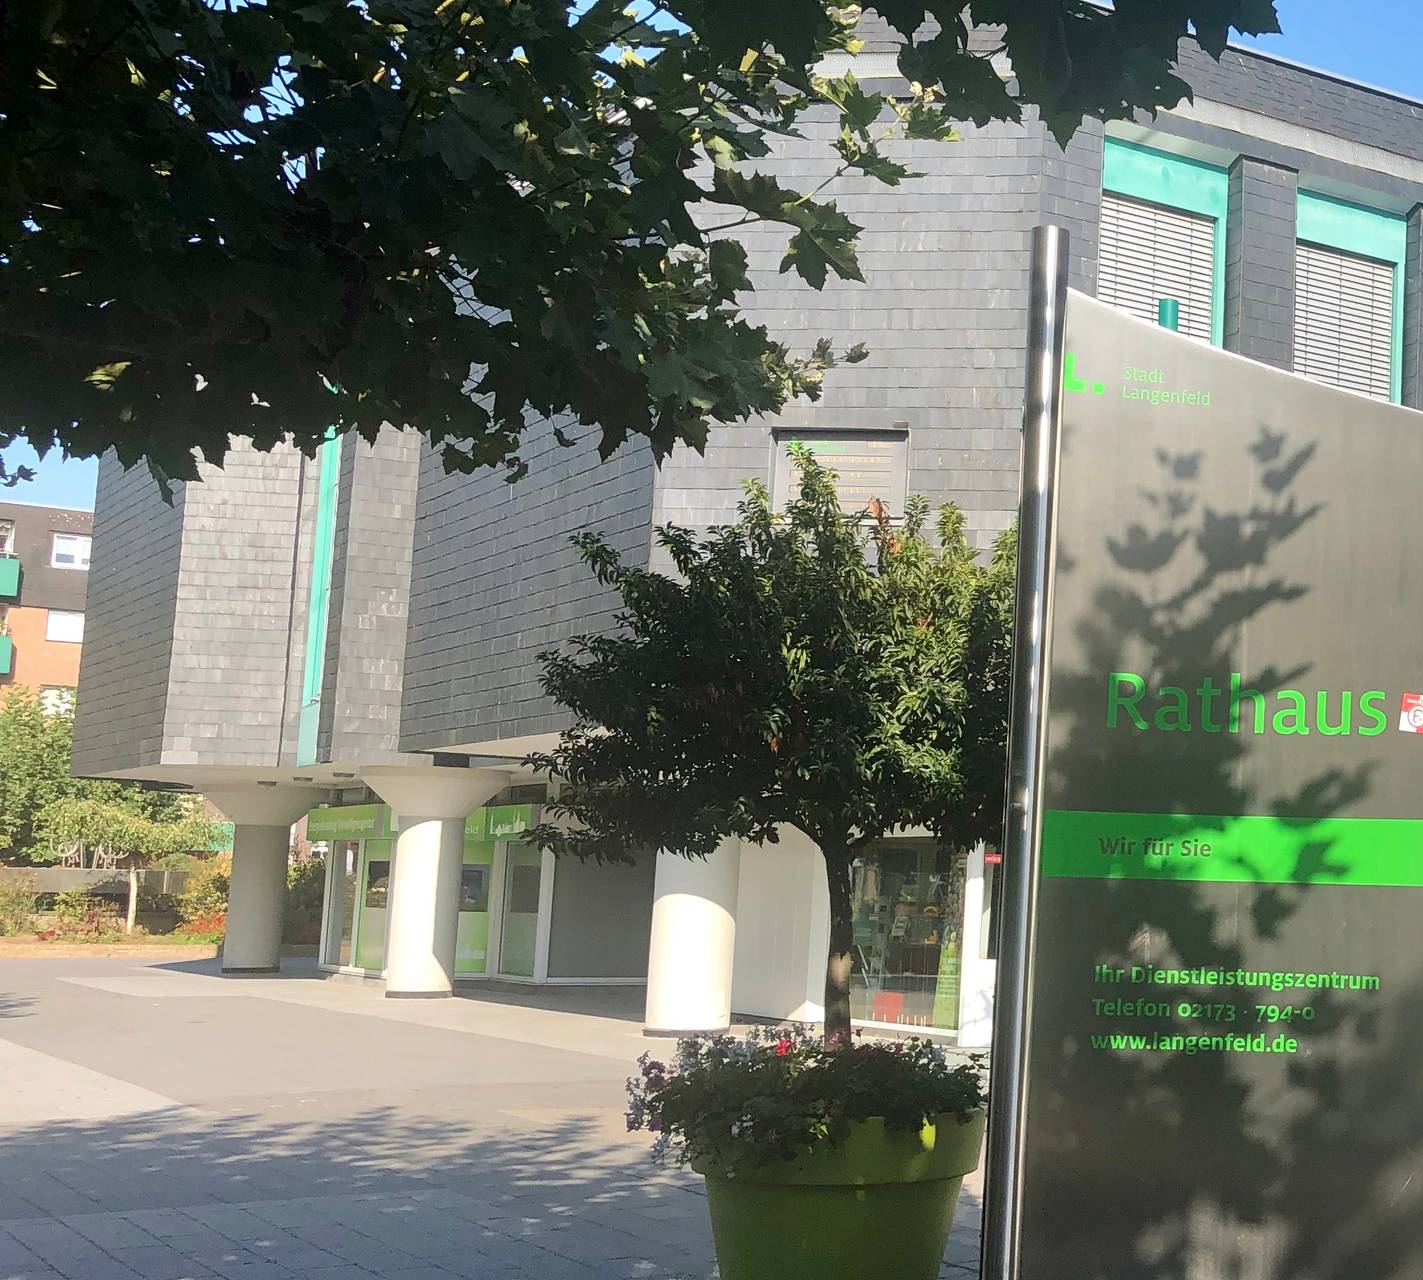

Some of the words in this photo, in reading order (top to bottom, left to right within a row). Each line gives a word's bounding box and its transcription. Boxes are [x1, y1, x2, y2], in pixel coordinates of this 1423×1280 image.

[1123, 366, 1165, 384] Stadt
[1122, 384, 1211, 406] Langenfeld
[1105, 671, 1387, 737] Rathaus
[1099, 837, 1137, 856] Wir
[1142, 837, 1174, 857] für
[1180, 839, 1212, 857] Sie
[1094, 964, 1124, 984] Ihr
[1131, 965, 1380, 991] Dienstleistungszentrum
[1091, 998, 1170, 1018] Telefon
[1177, 1002, 1236, 1022] 02173
[1255, 1004, 1316, 1023] 794-0
[1091, 1033, 1298, 1055] www.langenfeld.de
